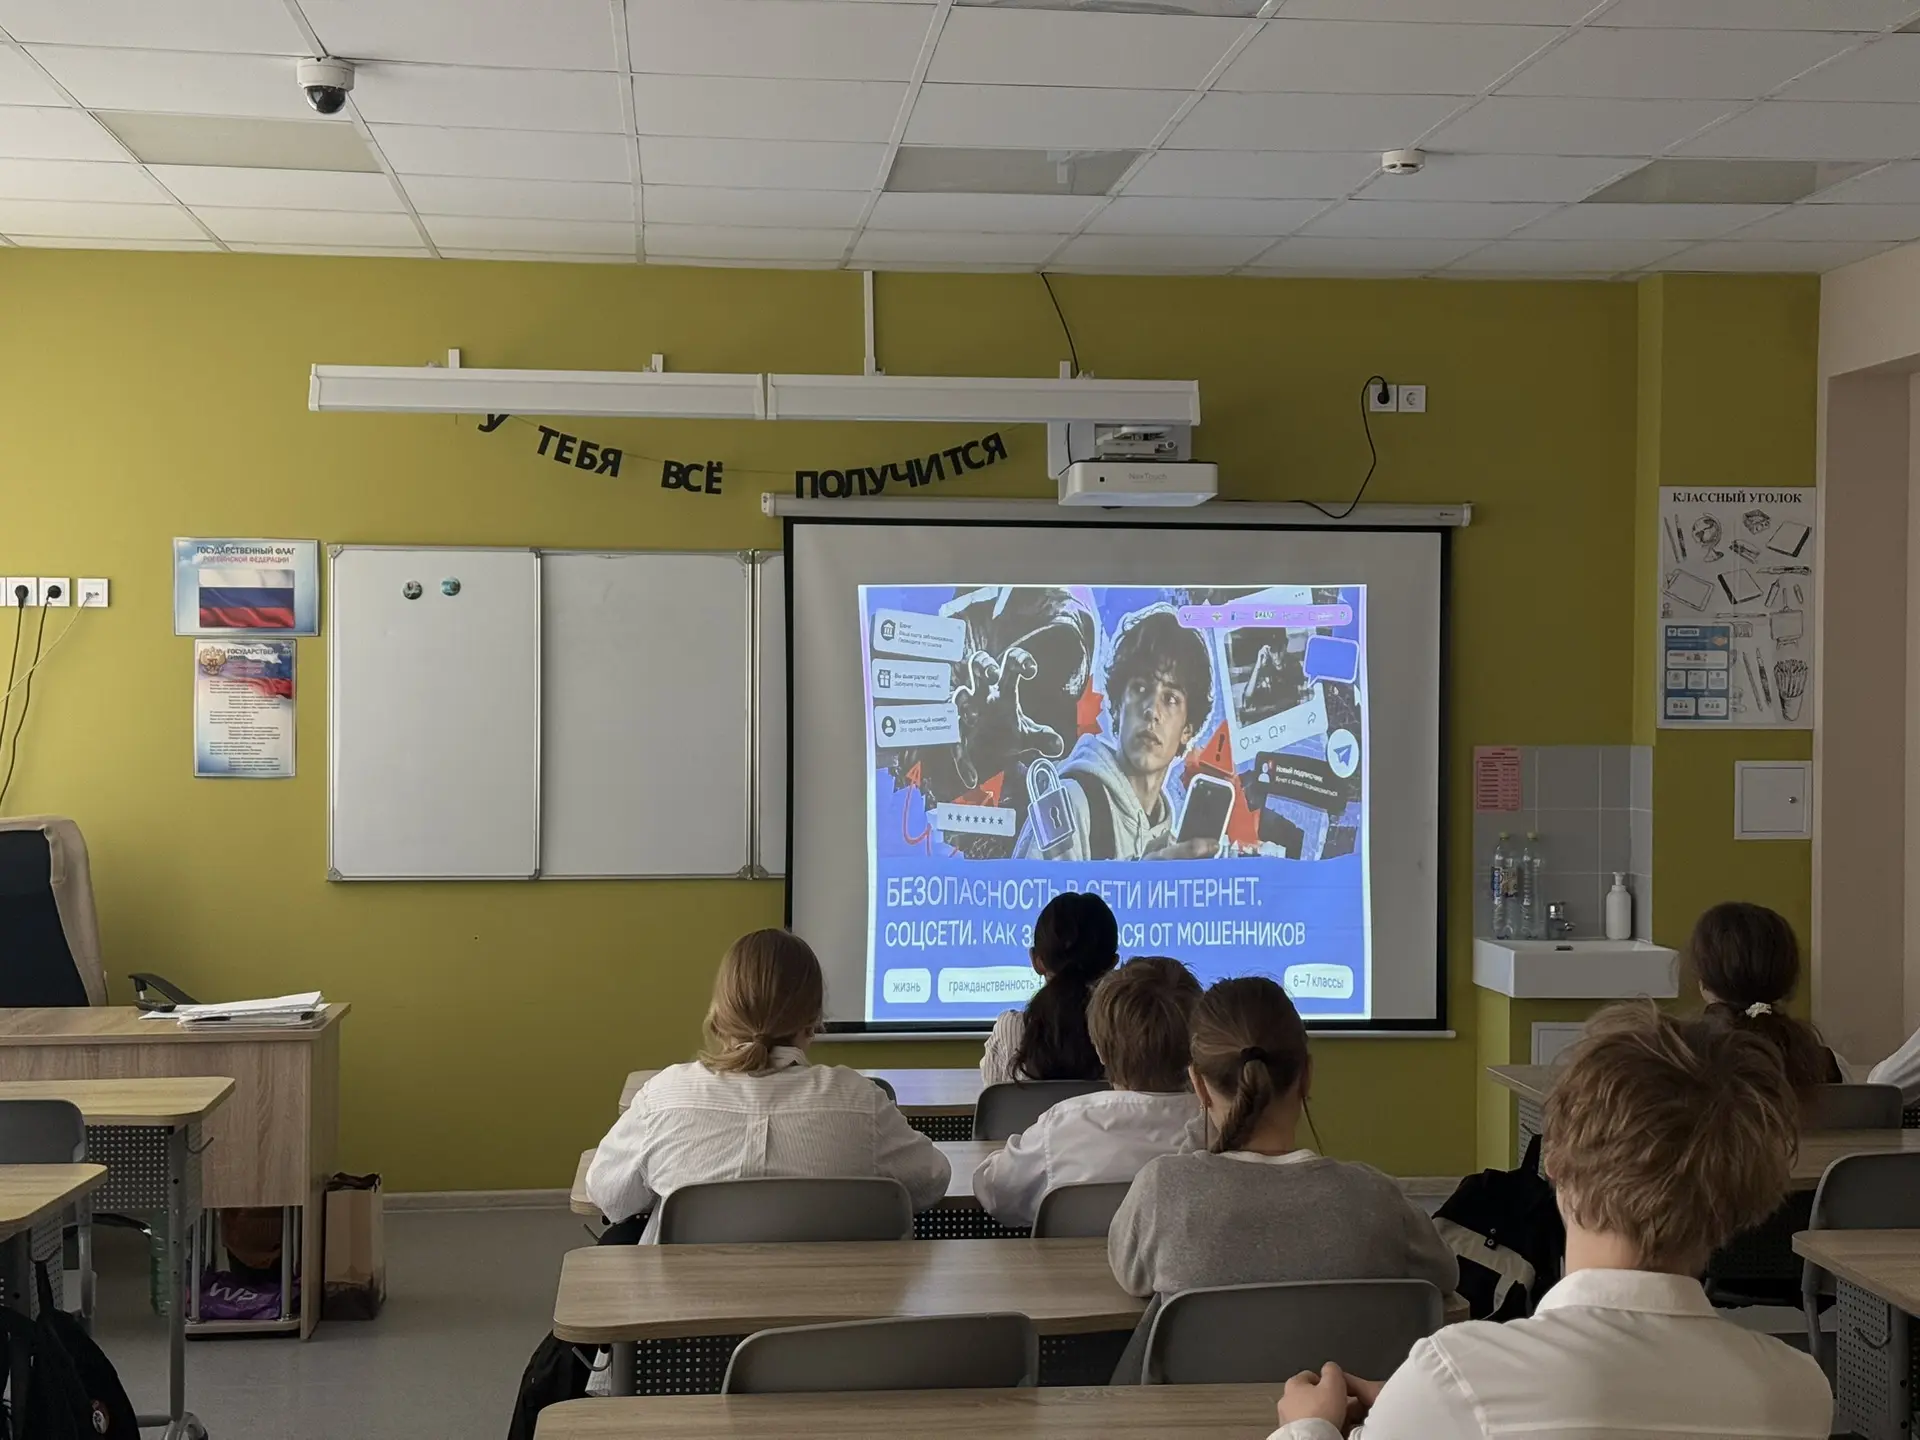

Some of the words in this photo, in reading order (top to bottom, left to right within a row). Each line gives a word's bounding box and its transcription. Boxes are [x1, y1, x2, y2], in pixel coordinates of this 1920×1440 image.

[536, 425, 623, 478] ТЕБЯ
[661, 460, 723, 495] ВСЁ
[795, 432, 1008, 499] ПОЛУЧИТСЯ
[1672, 490, 1746, 503] КЛАССНЫЙ
[1749, 493, 1802, 503] УГОЛОК
[197, 546, 274, 555] ГОСУДАРСТВЕННЫЙ
[1147, 877, 1262, 909] ИНТЕРНЕТ.
[885, 920, 977, 950] СОЦСЕТИ.
[982, 920, 1017, 947] КАК
[1150, 923, 1173, 946] ОТ
[1177, 921, 1306, 946] МОШЕННИКОВ
[892, 981, 921, 993] жизнь
[948, 979, 1035, 995] гражданственность
[1312, 977, 1344, 989] классы
